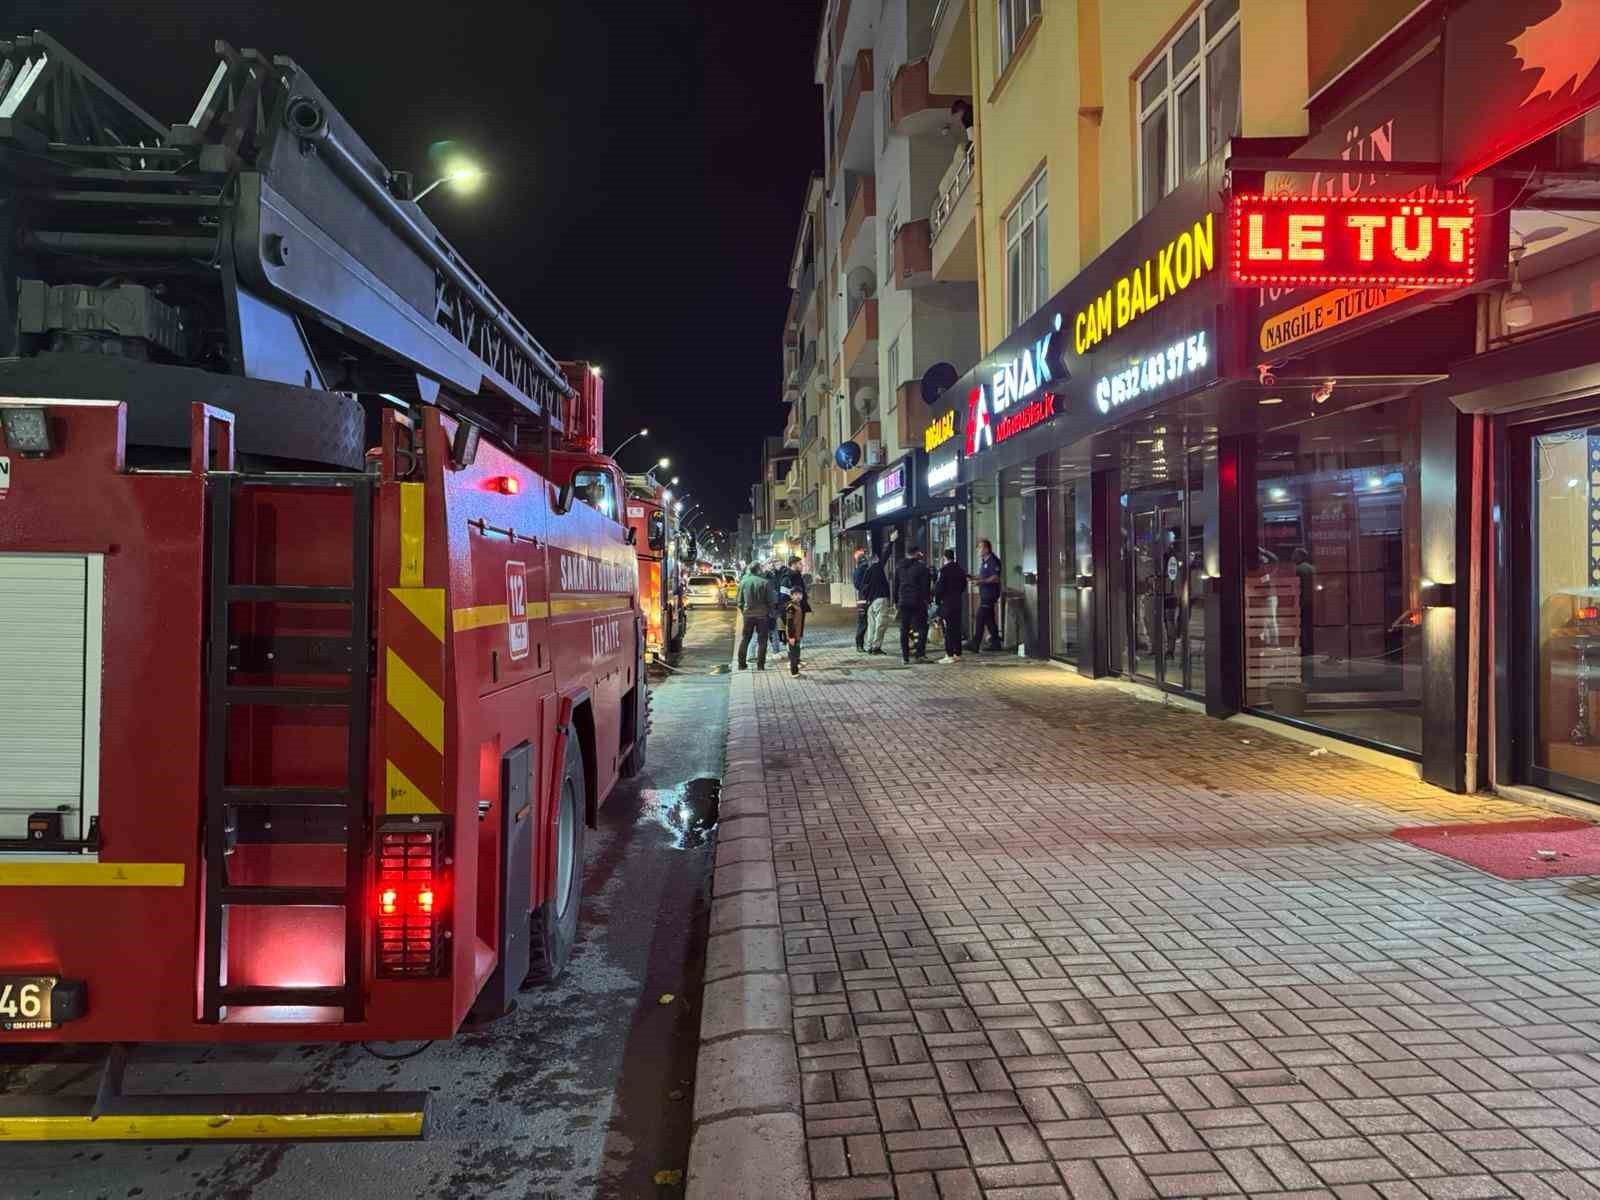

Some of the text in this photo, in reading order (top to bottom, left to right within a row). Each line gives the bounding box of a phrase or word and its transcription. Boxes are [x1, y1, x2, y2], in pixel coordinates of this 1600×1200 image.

[1248, 206, 1474, 263] LE TÜT
[1075, 212, 1214, 355] CAM BALKON
[1186, 330, 1208, 371] 54
[1265, 306, 1324, 349] NARGİLE
[992, 332, 1052, 414] ENAK
[509, 575, 525, 617] 112
